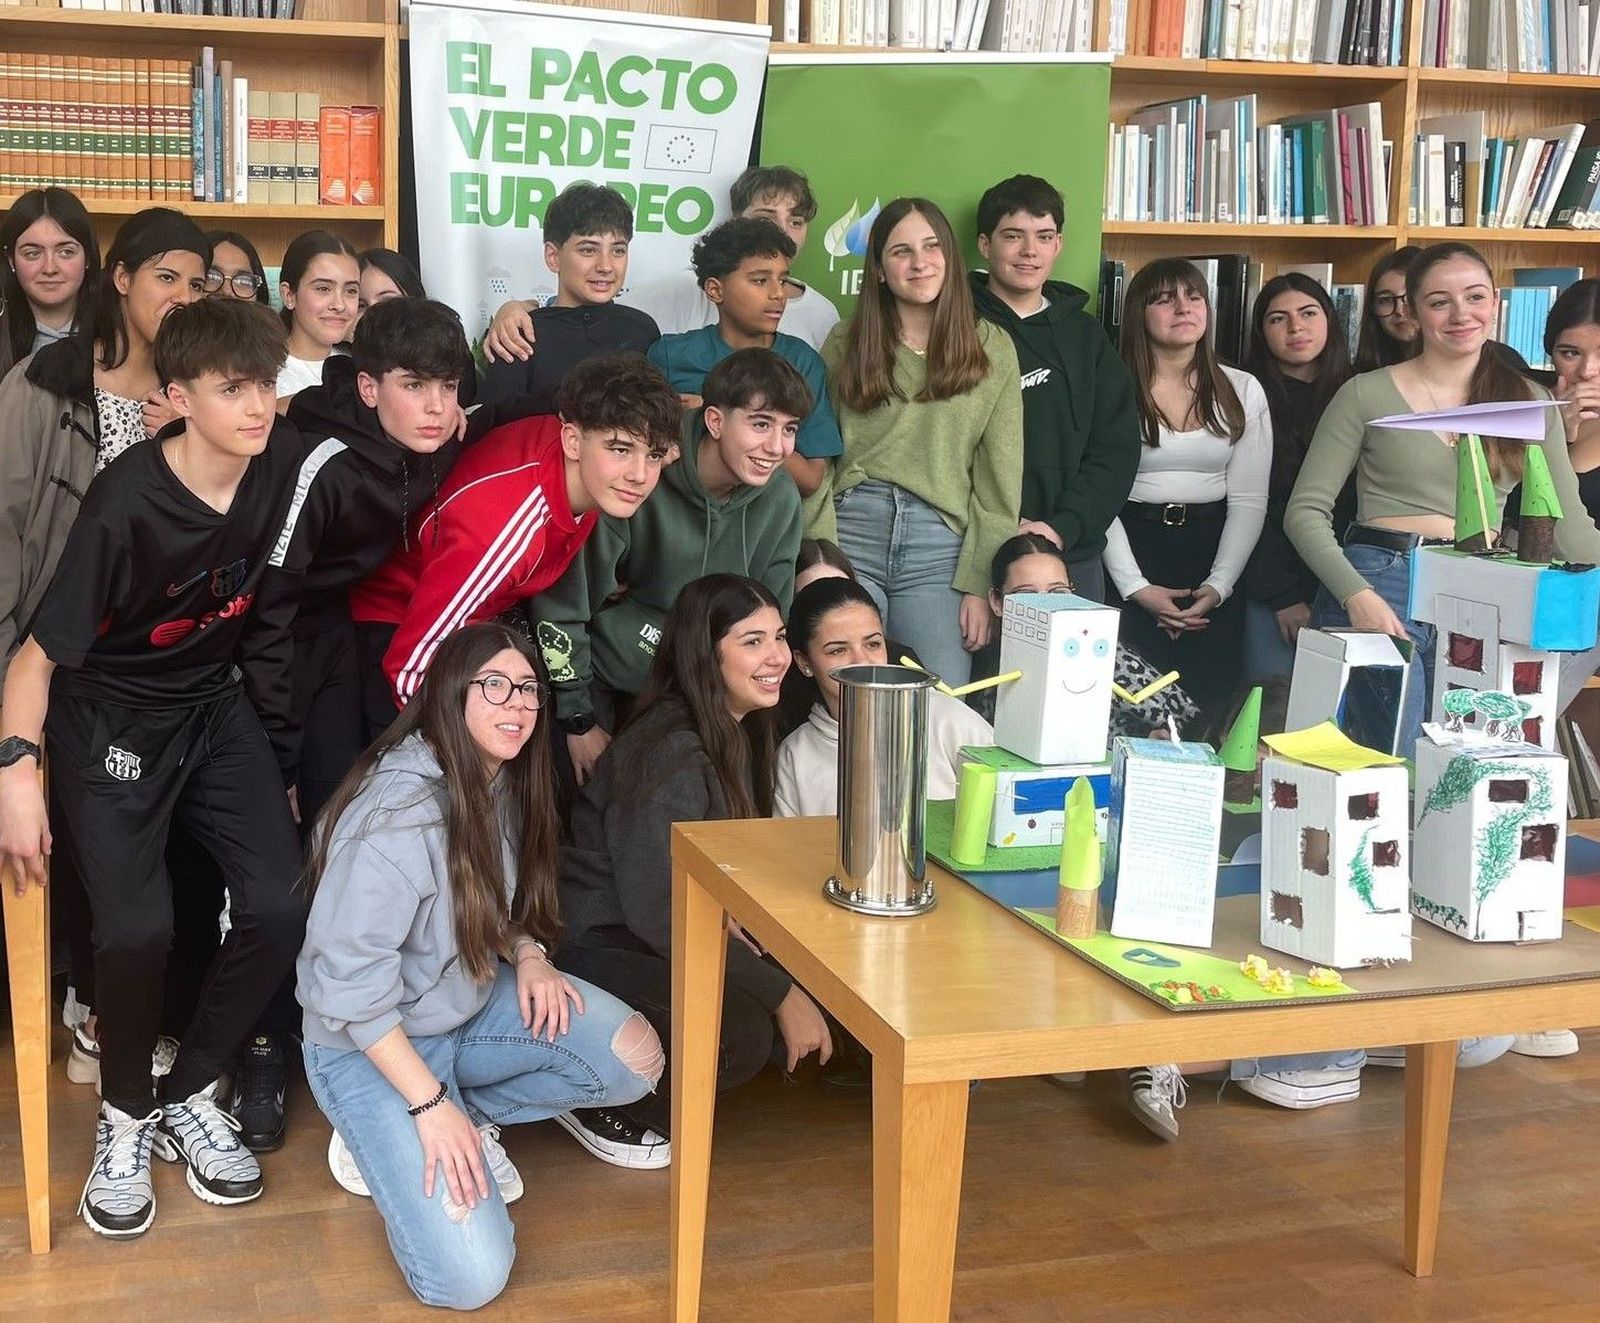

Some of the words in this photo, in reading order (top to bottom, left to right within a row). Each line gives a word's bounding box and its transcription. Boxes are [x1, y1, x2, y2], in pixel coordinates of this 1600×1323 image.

[446, 41, 506, 98] EL
[529, 47, 738, 115] PACTO
[448, 107, 635, 170] VERDE
[450, 172, 715, 236] EUREO
